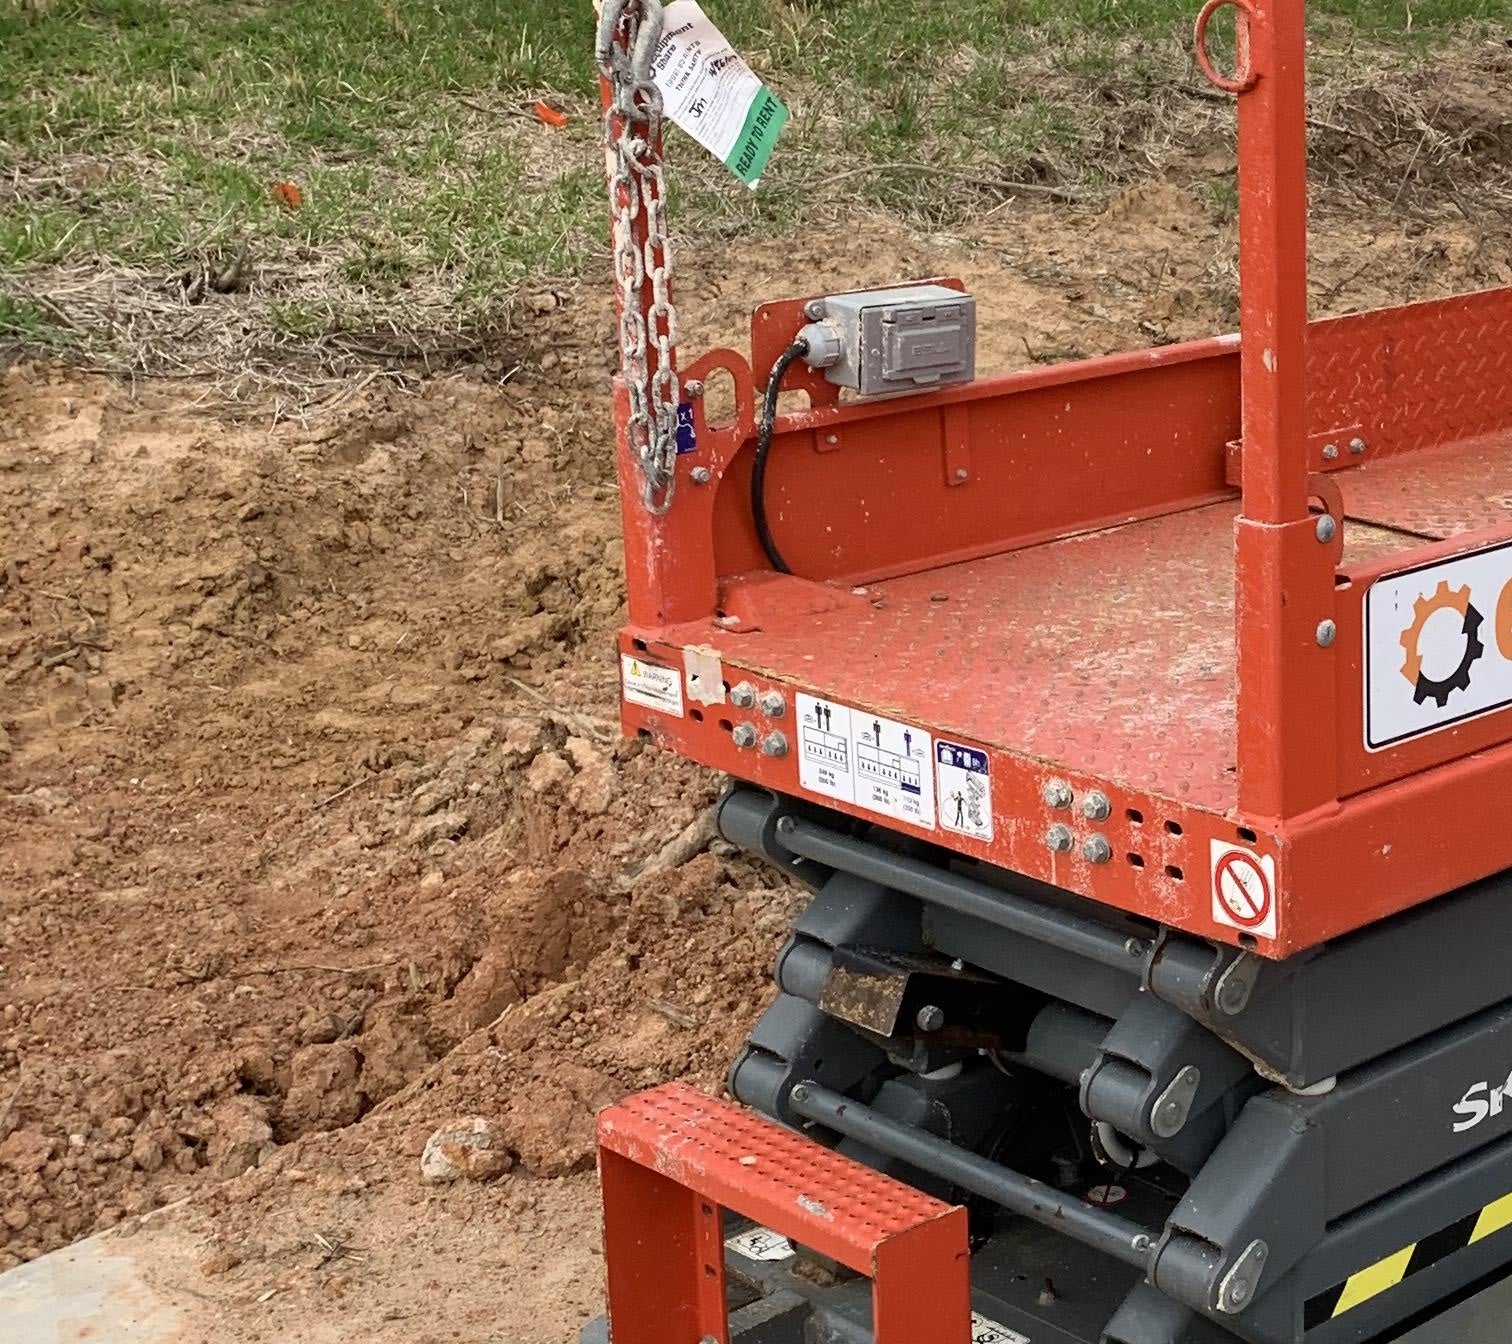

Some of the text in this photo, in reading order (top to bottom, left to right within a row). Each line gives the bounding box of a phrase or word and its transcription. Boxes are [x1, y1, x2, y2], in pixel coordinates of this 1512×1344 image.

[656, 44, 677, 71] Share
[735, 96, 778, 177] READY TO RENT
